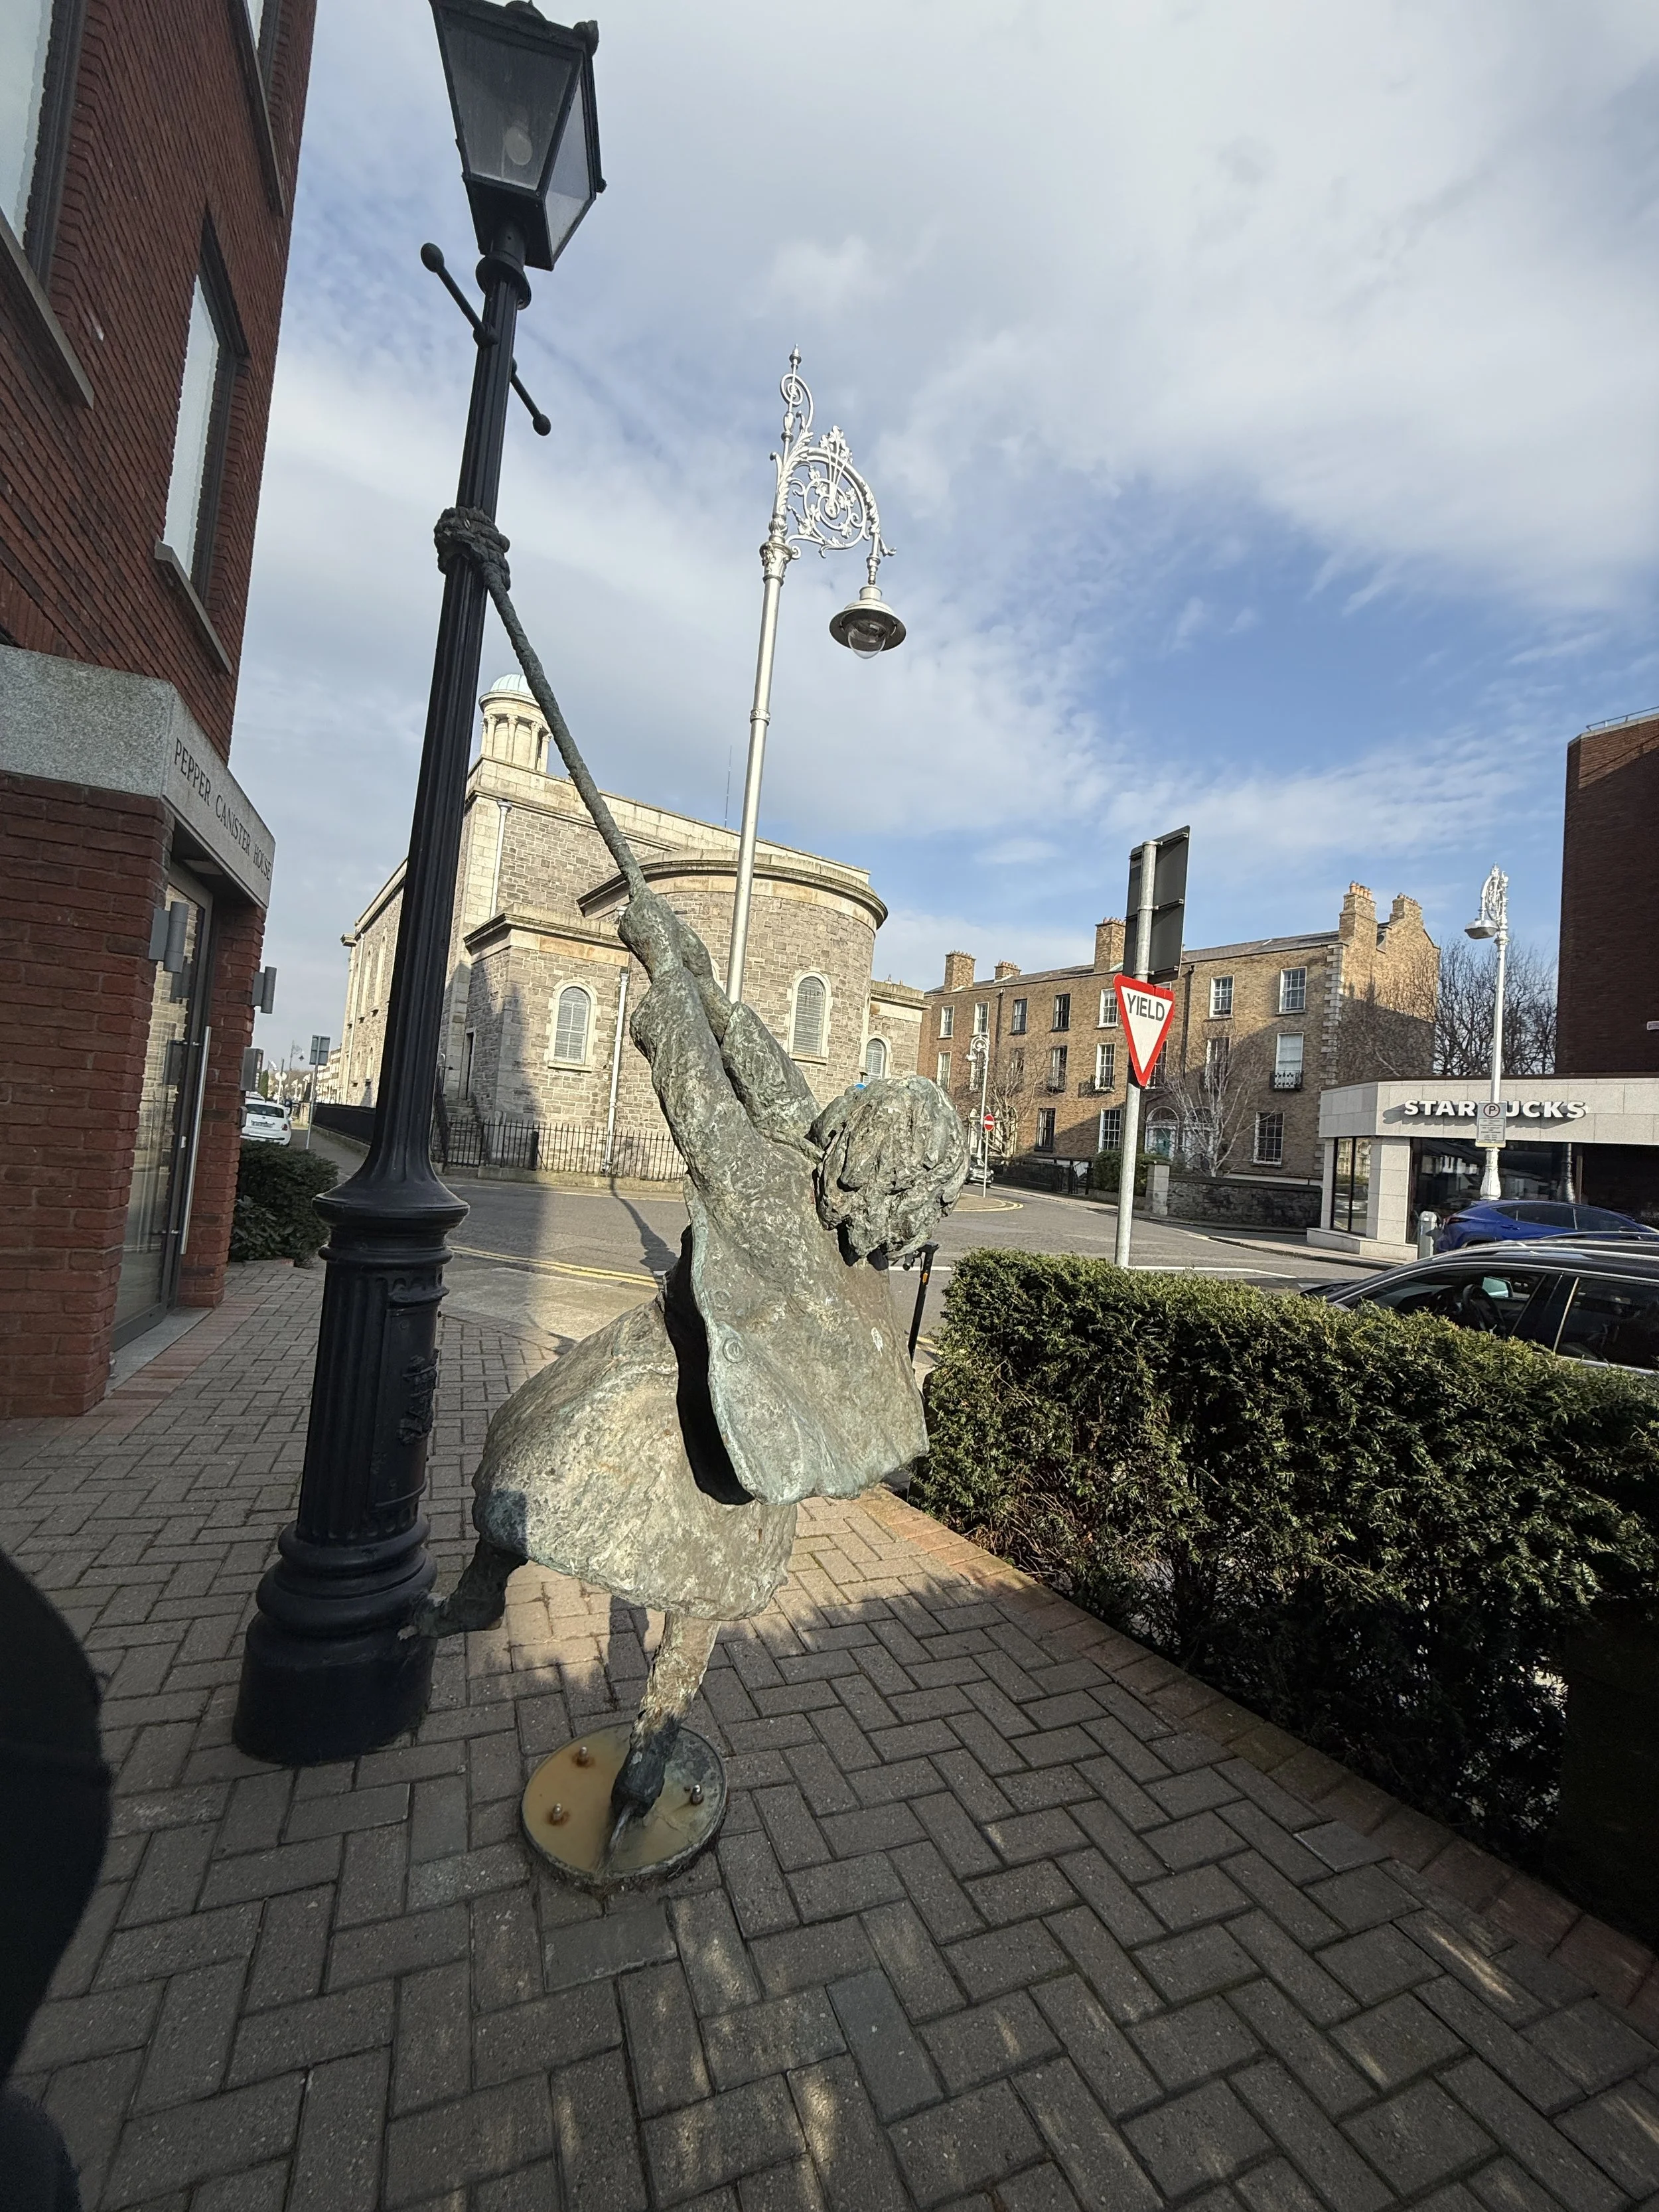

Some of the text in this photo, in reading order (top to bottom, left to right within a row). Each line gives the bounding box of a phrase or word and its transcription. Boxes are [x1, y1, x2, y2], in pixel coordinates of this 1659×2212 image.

[174, 737, 271, 881] PEPPER CANISTER HOUSE
[1127, 992, 1165, 1021] YIELD
[1404, 1099, 1587, 1119] STARUCKS
